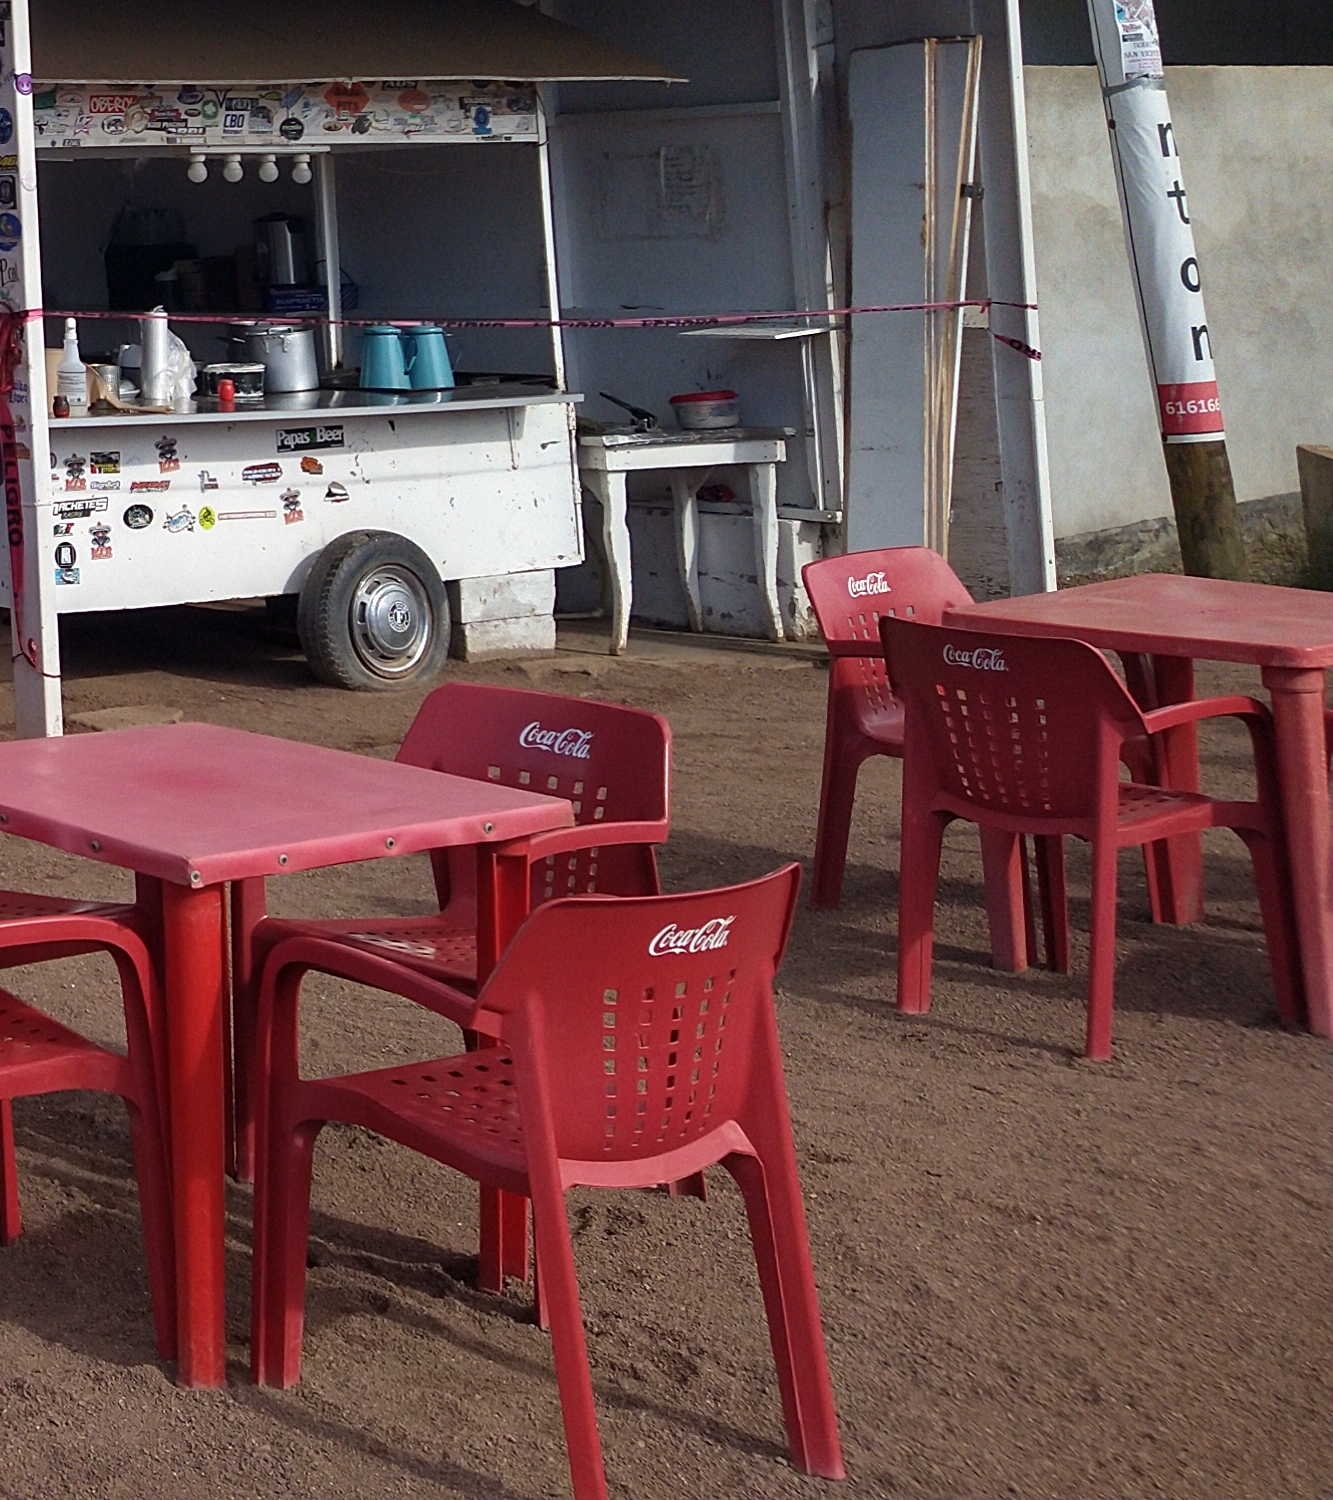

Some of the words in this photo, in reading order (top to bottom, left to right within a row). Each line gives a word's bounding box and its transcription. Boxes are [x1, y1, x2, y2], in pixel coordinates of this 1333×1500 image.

[277, 430, 311, 449] Papas
[316, 426, 344, 442] Beer
[0, 424, 24, 547] PELIGRO
[847, 571, 892, 598] Coca-Cola
[942, 643, 1007, 671] Coca-Cola
[519, 721, 595, 759] Coca-Cola
[648, 915, 737, 957] Coca-Cola
